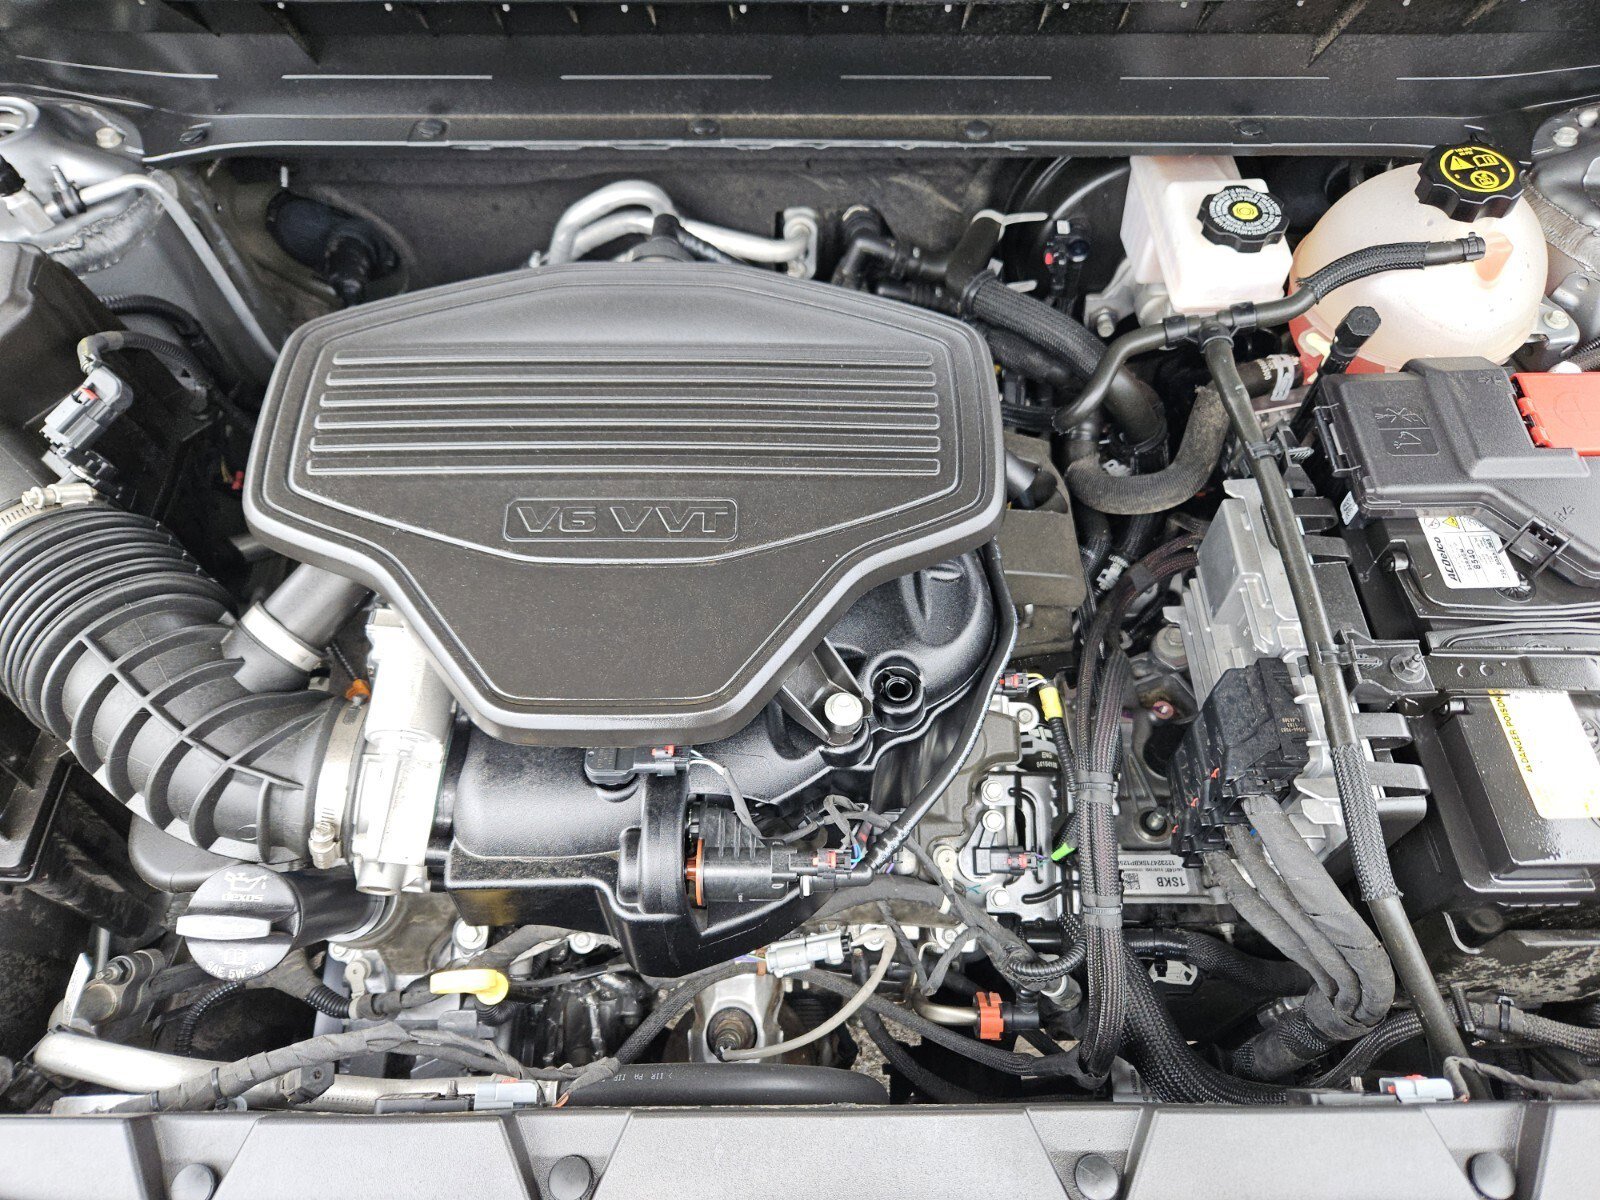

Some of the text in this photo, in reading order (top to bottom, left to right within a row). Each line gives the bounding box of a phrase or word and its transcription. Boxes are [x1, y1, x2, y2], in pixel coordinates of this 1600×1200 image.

[516, 506, 729, 533] V6 VVT
[1433, 536, 1459, 582] ACDelco
[1466, 549, 1481, 570] 8540
[1510, 730, 1529, 763] DANGER
[1156, 876, 1186, 887] 1SKB
[221, 893, 264, 902] dexos
[205, 960, 267, 979] SAE 5W-30
